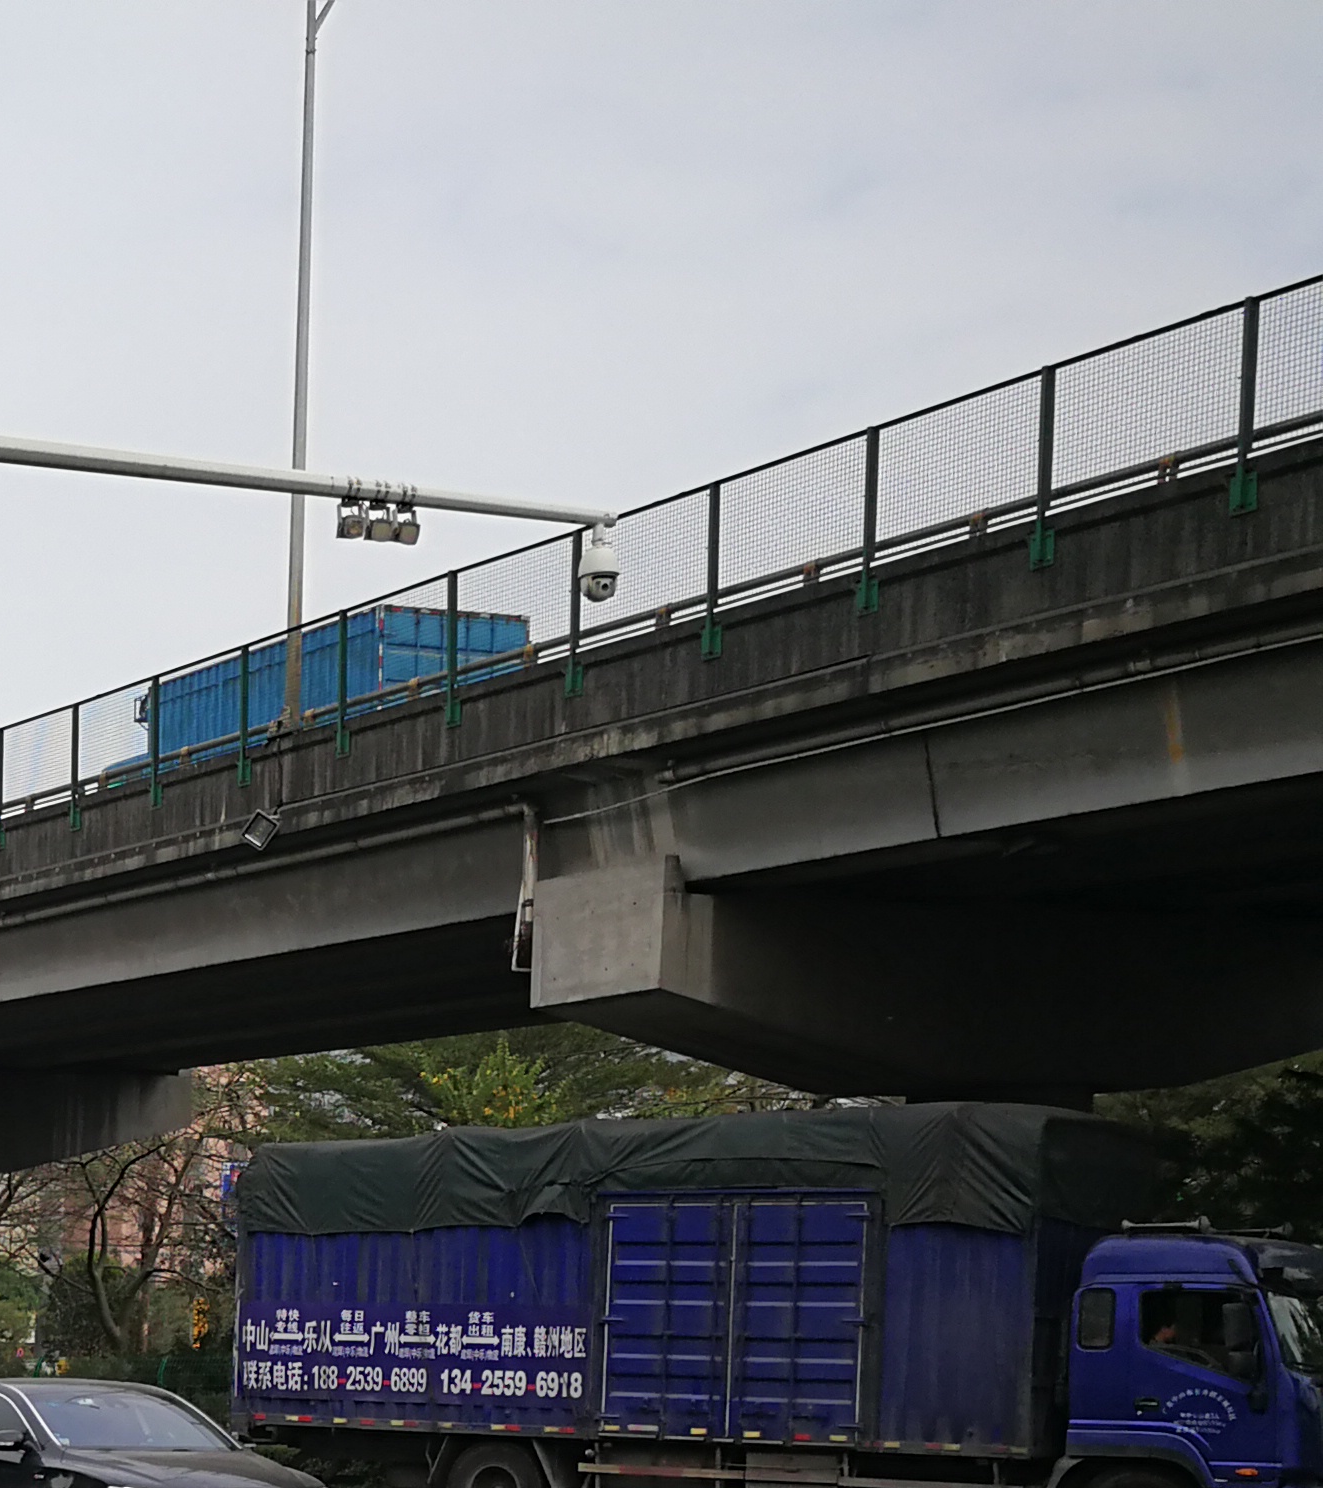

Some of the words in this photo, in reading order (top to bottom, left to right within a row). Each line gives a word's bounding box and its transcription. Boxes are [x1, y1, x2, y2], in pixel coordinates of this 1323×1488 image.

[276, 1308, 300, 1321] 特快
[341, 1309, 365, 1322] 每日
[468, 1311, 495, 1324] 货车
[242, 1318, 269, 1352] 中山
[303, 1320, 333, 1354] 乐从
[369, 1321, 400, 1356] 广州
[435, 1323, 463, 1356] 花都
[468, 1324, 494, 1337] 出租
